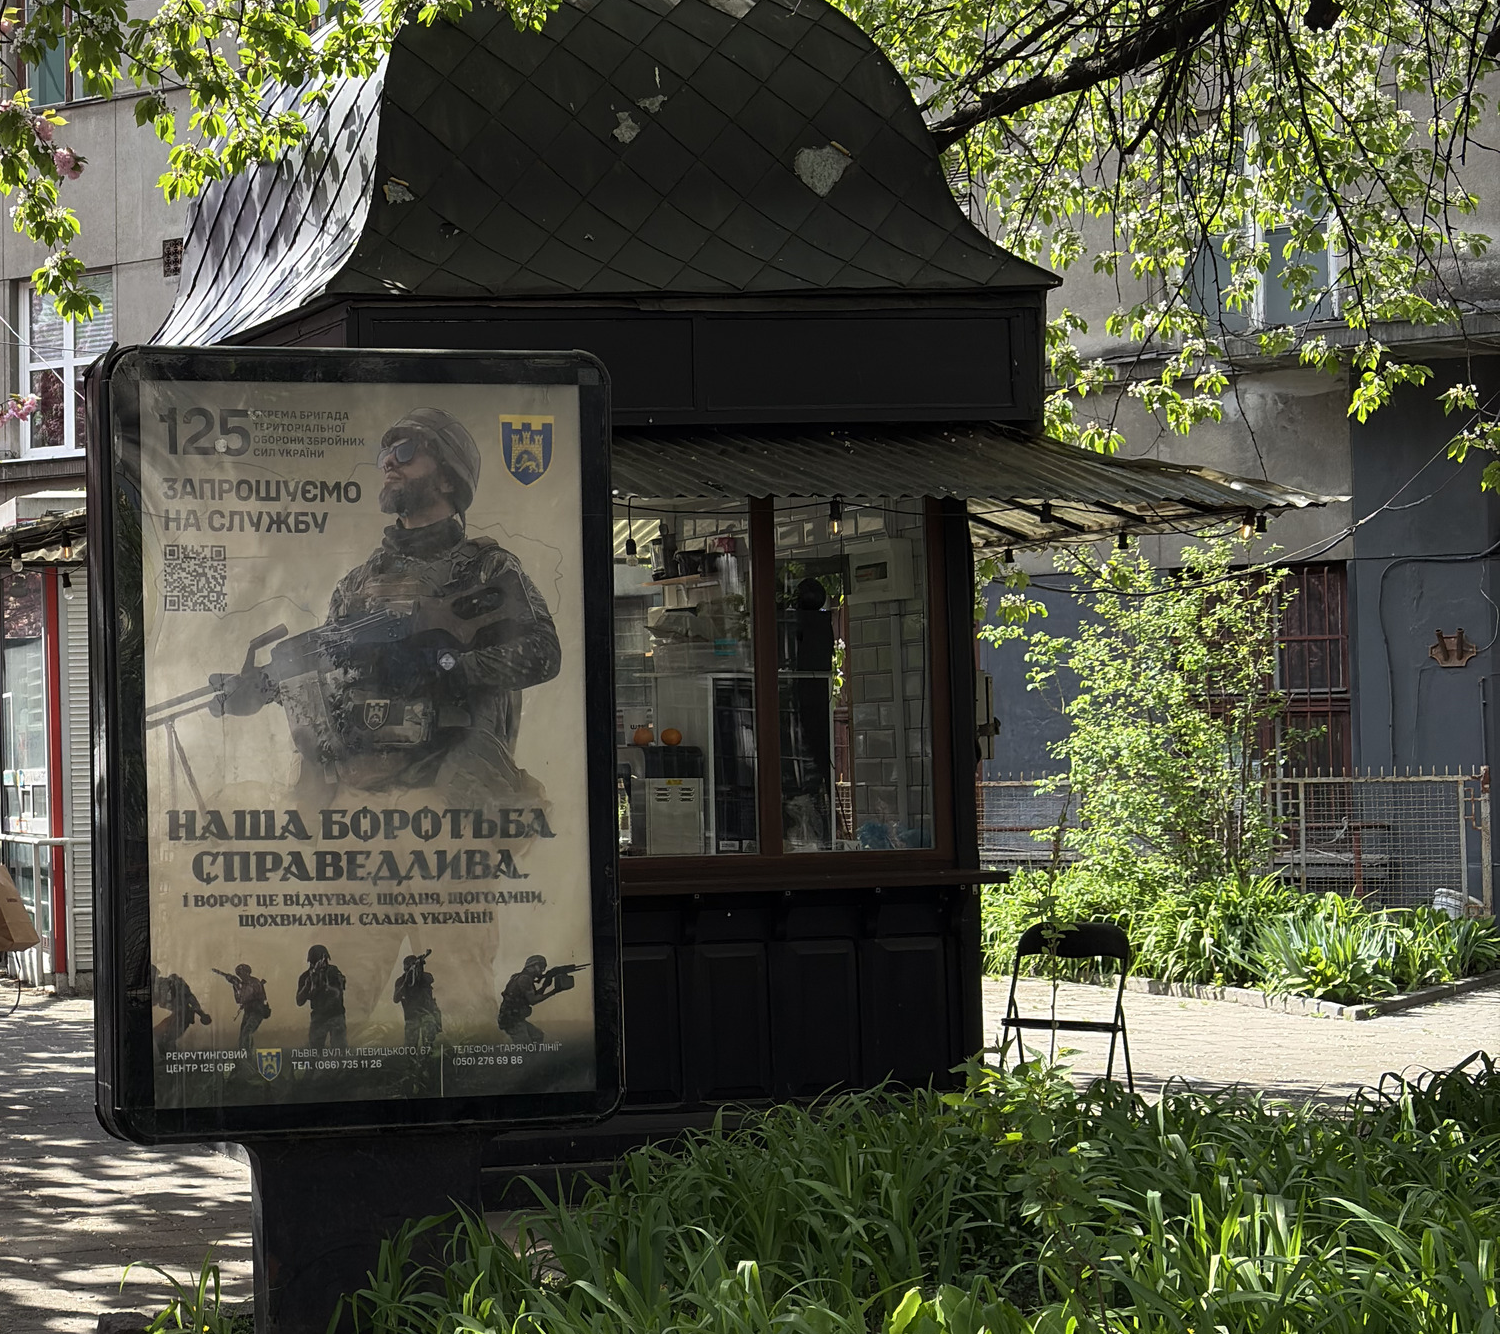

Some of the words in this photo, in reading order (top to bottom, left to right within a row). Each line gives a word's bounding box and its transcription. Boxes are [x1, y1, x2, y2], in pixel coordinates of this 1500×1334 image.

[253, 410, 297, 421] ОКРЕМА
[300, 410, 349, 422] БРИГАДА
[159, 407, 250, 456] 125
[253, 422, 346, 434] ТЕРИТОРІАЛЬНОЇ
[253, 435, 304, 445] ОБОРОНИ
[307, 435, 365, 447] ЗБРОЙНИХ
[253, 448, 276, 457] СИЛ
[279, 447, 325, 458] УКРАЇНИ
[162, 478, 361, 503] ЗАПРОШУЄМО
[163, 509, 201, 532] НА
[207, 510, 328, 534] СЛУЖБУ
[165, 809, 313, 841] НАША
[318, 805, 557, 843] БОРОТЬБА
[192, 848, 530, 886] СПРАВЕДЛИВА.
[193, 893, 253, 908] ВОРОГ
[255, 894, 280, 909] ЦЕ
[283, 891, 373, 909] ВІДЧУВАЄ,
[377, 891, 445, 907] ЩОДНЯ,
[447, 890, 547, 907] ЩОГОДИНИ,
[238, 913, 355, 929] ЩОХВИЛИНИ.
[358, 912, 418, 927] СЛАВА
[166, 1048, 247, 1061] РЕКРУТИНГОВИЙ
[322, 1048, 342, 1057] ВУЛ.
[345, 1048, 353, 1057] К.
[356, 1046, 418, 1058] ЛЕВИЦЬКОГО,
[420, 1046, 431, 1055] 67
[453, 1045, 495, 1054] ТЕЛЕФОН
[291, 1061, 313, 1070] ТЕЛ.
[314, 1061, 340, 1070] (066)
[342, 1060, 359, 1069] 735
[360, 1060, 368, 1069] 11
[370, 1059, 383, 1068] 26
[452, 1057, 476, 1066] (050)
[477, 1056, 495, 1066] 276
[496, 1056, 509, 1065] 69
[510, 1056, 523, 1065] 86
[166, 1063, 198, 1074] ЦЕНТР
[200, 1063, 215, 1073] 125
[217, 1063, 236, 1072] ОБР
